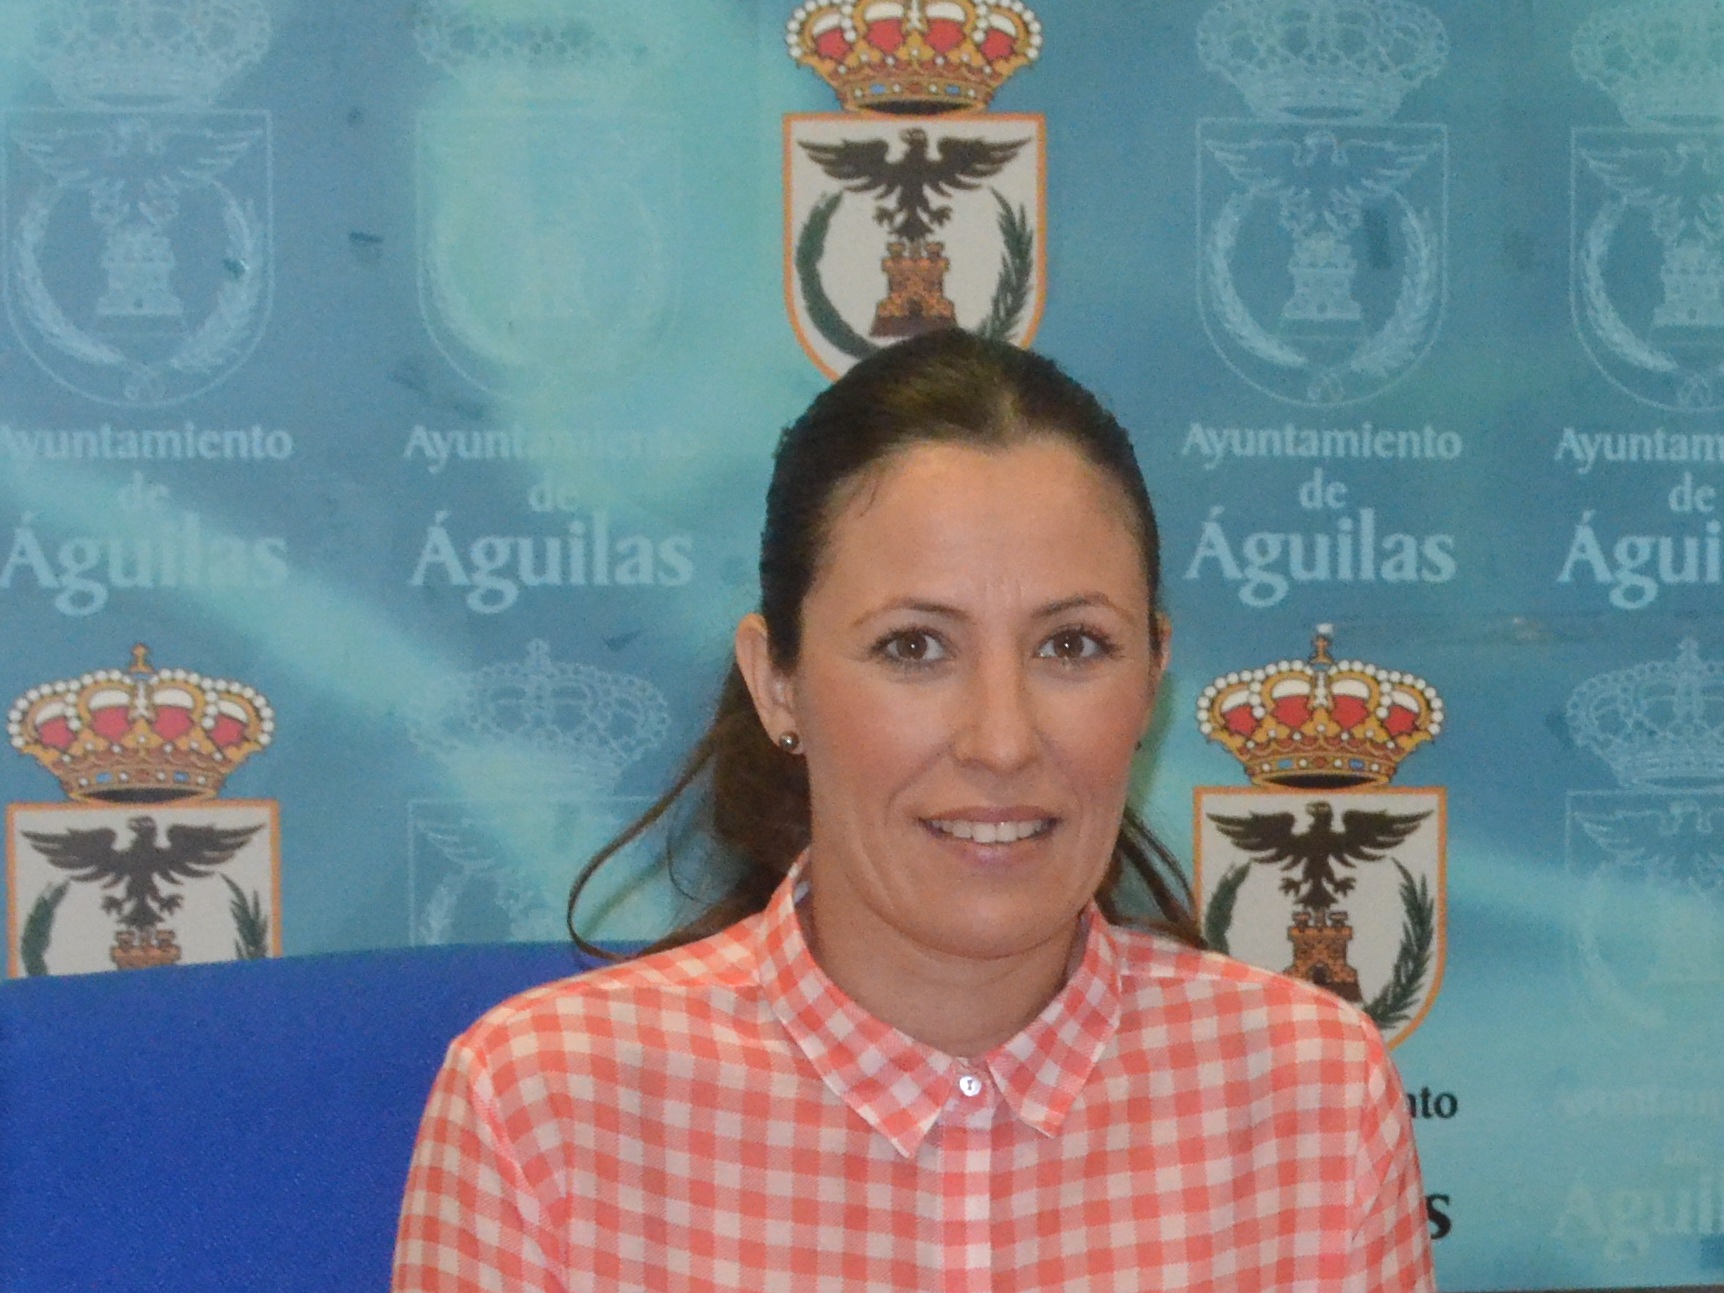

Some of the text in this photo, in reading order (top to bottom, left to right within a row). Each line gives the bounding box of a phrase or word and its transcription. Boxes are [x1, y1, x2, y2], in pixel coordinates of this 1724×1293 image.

[1182, 421, 1463, 470] Ayuntamiento
[1299, 466, 1349, 510] de
[1667, 471, 1716, 513] de
[409, 509, 696, 614] Águilas
[1182, 505, 1457, 607] Águilas
